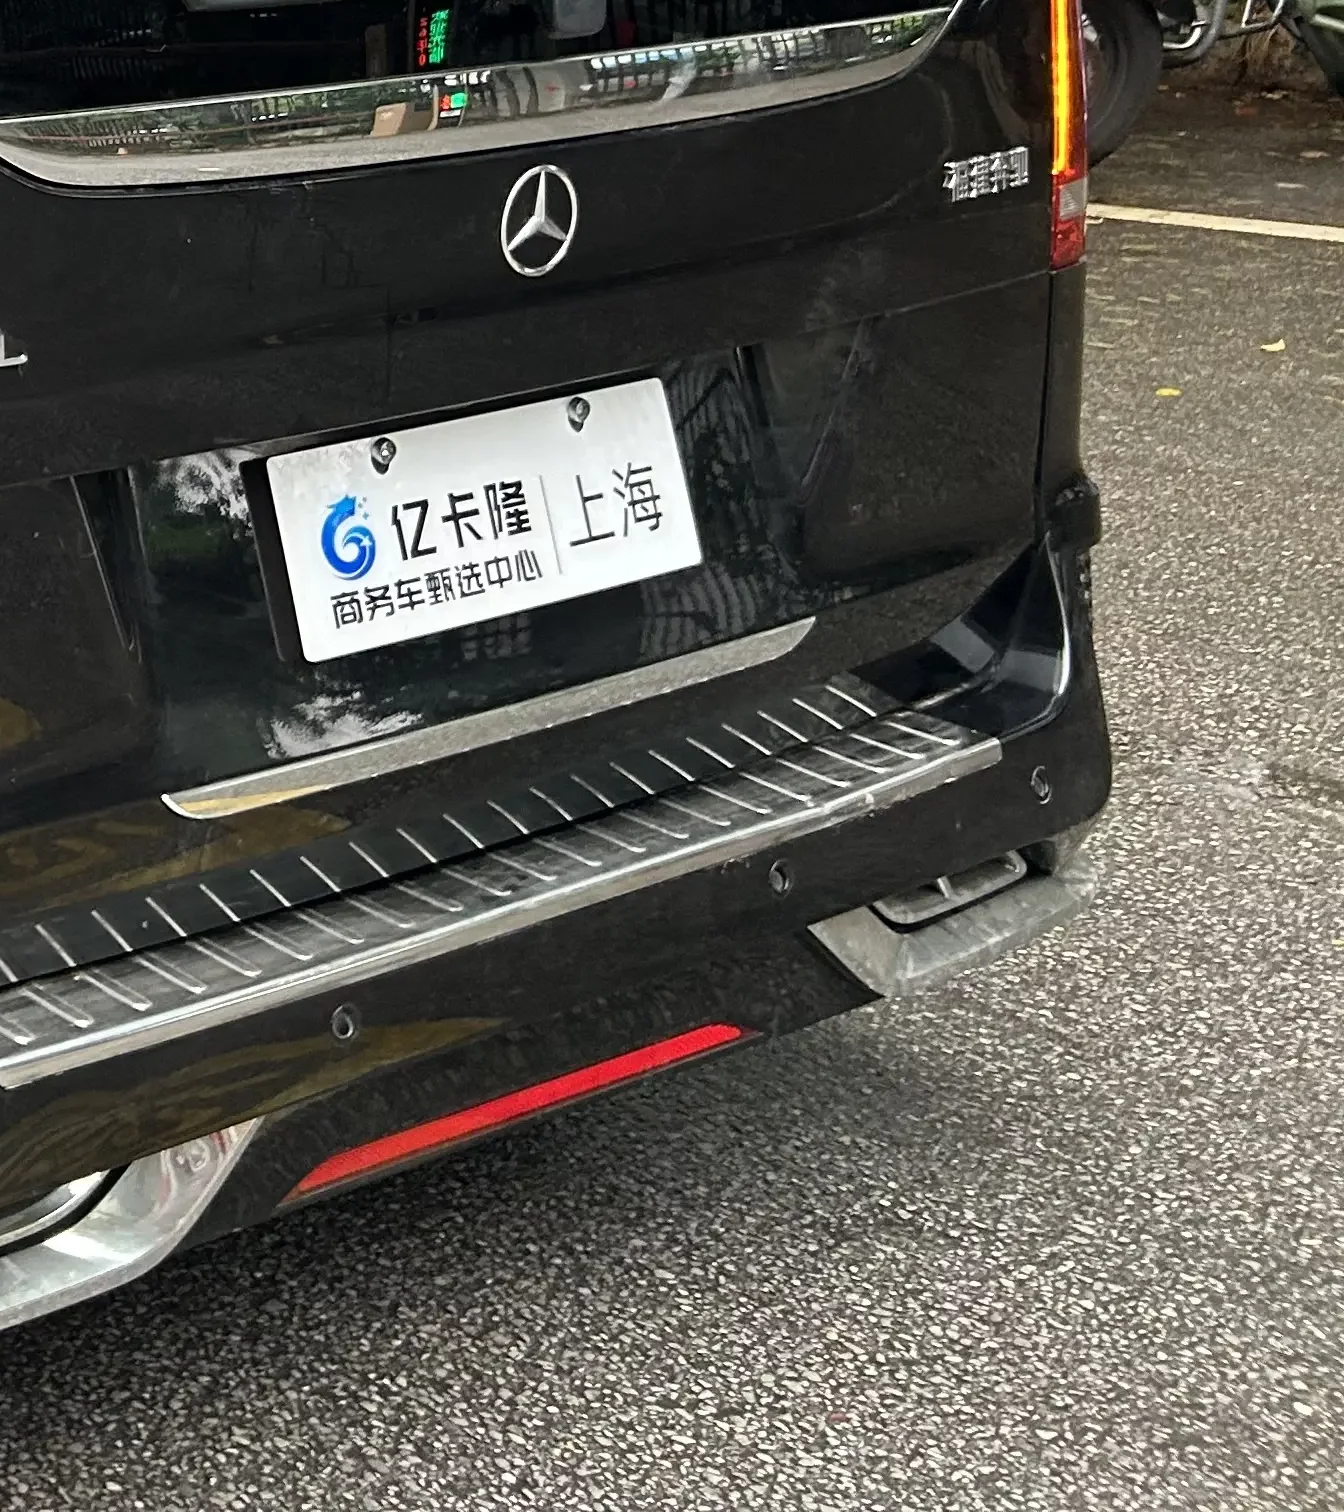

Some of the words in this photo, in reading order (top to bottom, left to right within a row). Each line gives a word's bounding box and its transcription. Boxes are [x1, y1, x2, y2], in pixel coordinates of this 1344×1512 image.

[391, 480, 533, 561] 亿卡隆
[569, 461, 663, 548] 上海
[330, 548, 544, 630] 商务车甄选中心
